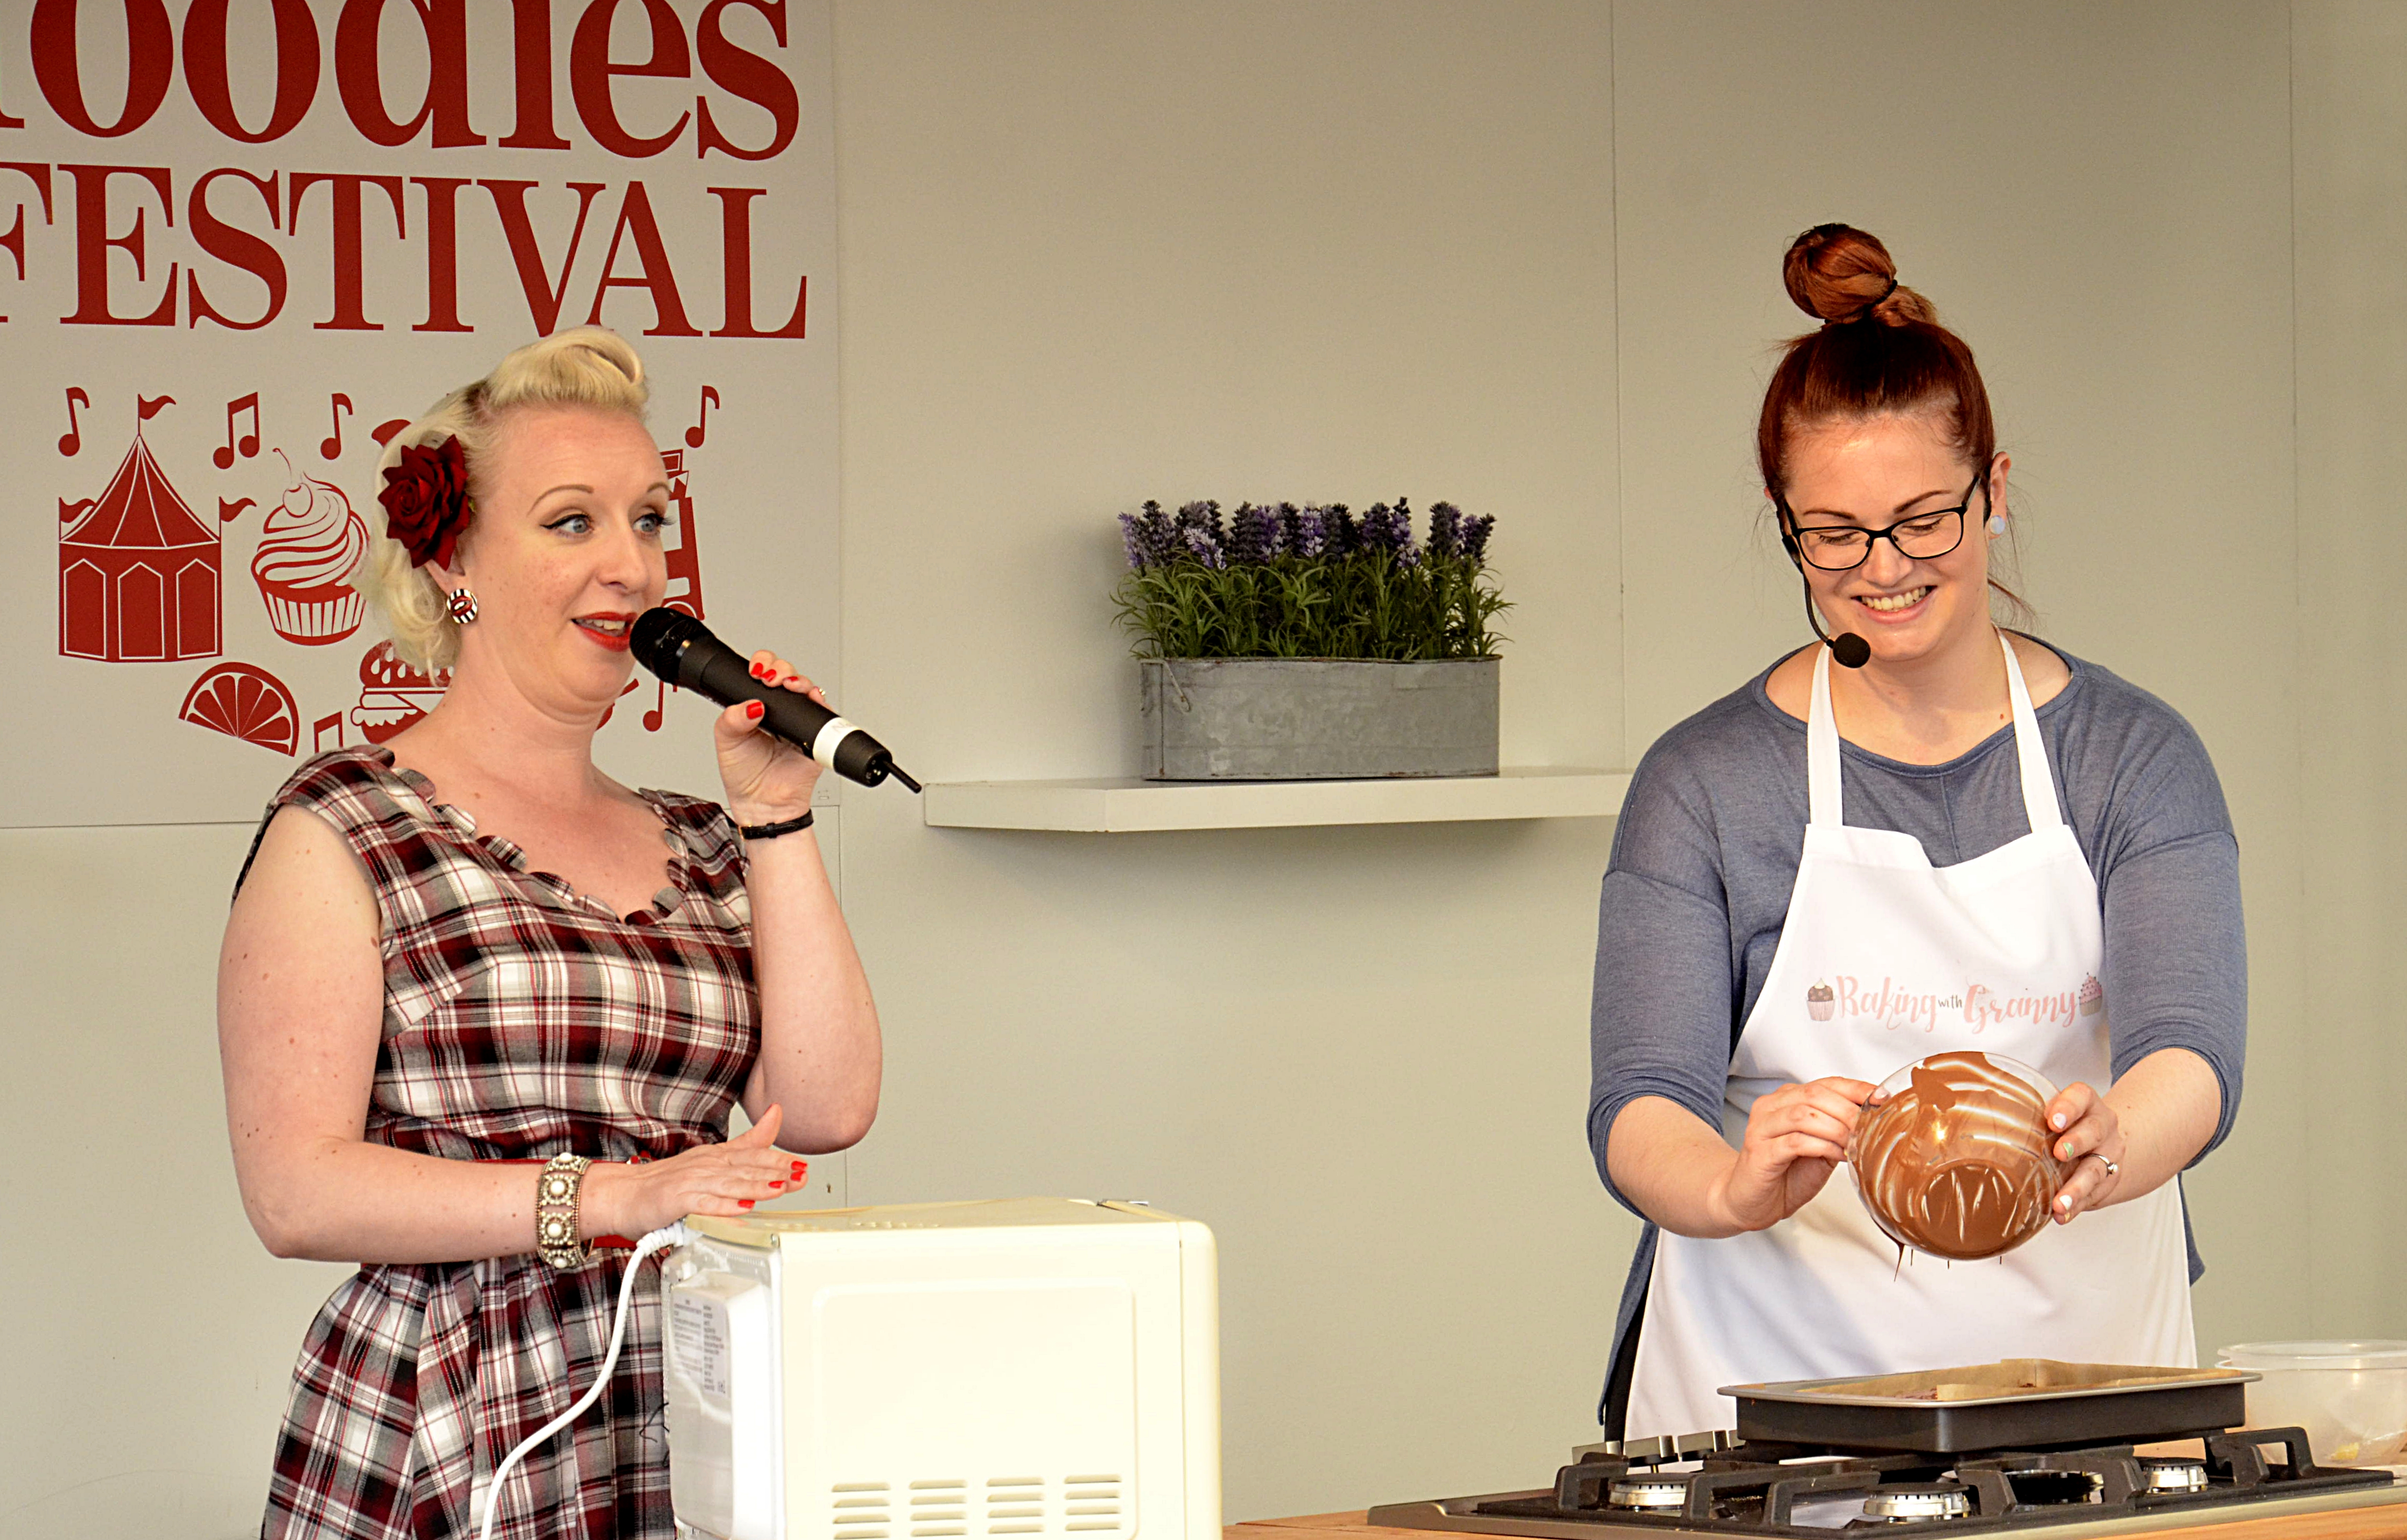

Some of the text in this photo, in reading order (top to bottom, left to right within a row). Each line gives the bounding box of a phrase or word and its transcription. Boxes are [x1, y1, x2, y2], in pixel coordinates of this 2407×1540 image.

[0, 0, 800, 161] oodies
[1835, 975, 2078, 1035] Baking with Granny
